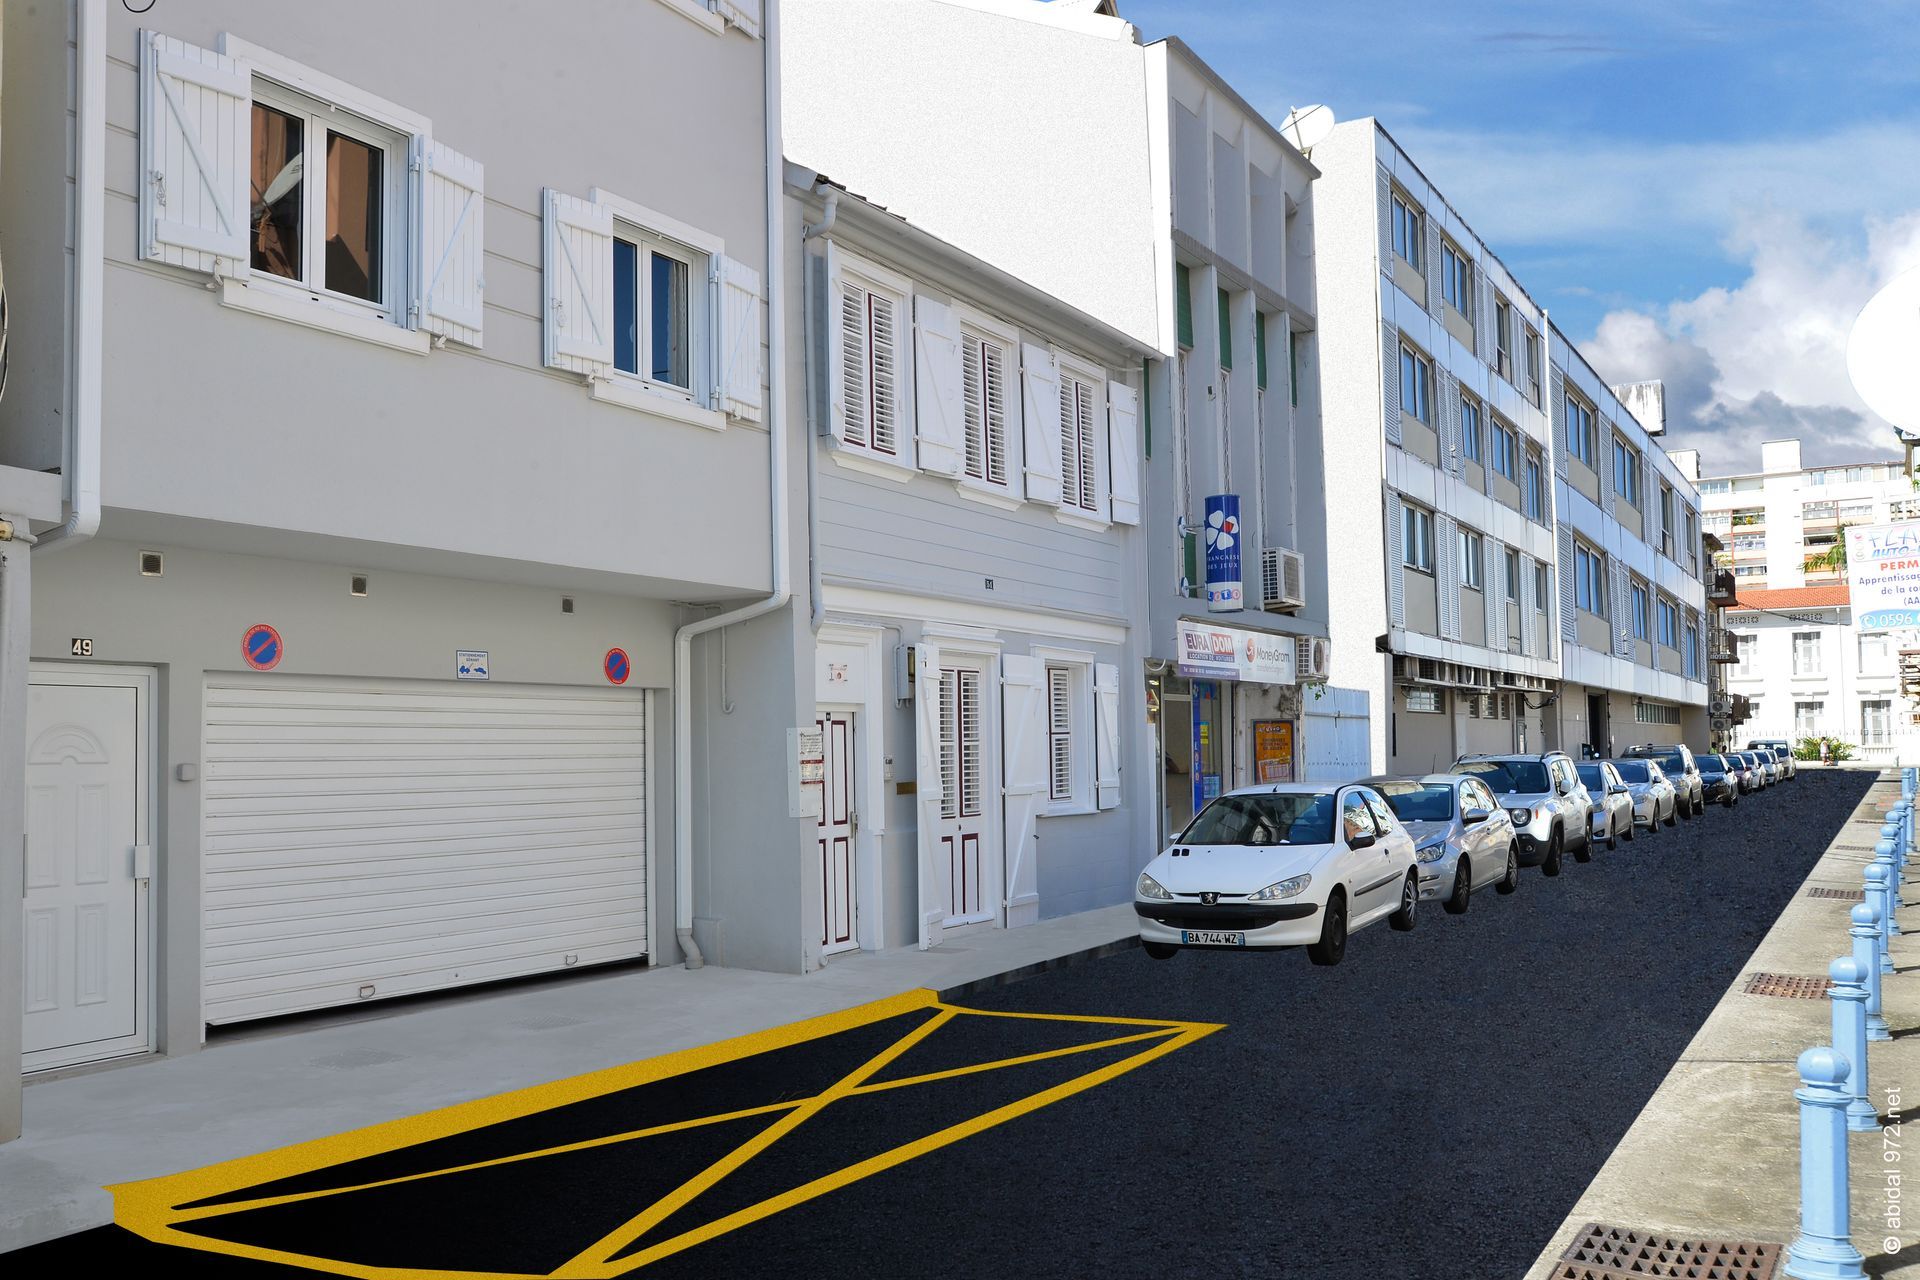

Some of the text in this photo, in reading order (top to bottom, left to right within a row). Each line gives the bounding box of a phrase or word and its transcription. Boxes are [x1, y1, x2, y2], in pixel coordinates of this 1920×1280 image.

[1868, 527, 1920, 548] FLA
[1872, 546, 1920, 558] AUTO-
[1208, 589, 1241, 601] LOTO
[1881, 587, 1893, 595] de
[1880, 612, 1913, 627] 0596
[72, 639, 92, 656] 49
[1185, 633, 1233, 653] EURA DOM
[1256, 647, 1290, 664] MoneyGram
[1188, 933, 1237, 943] BA-744-WZ
